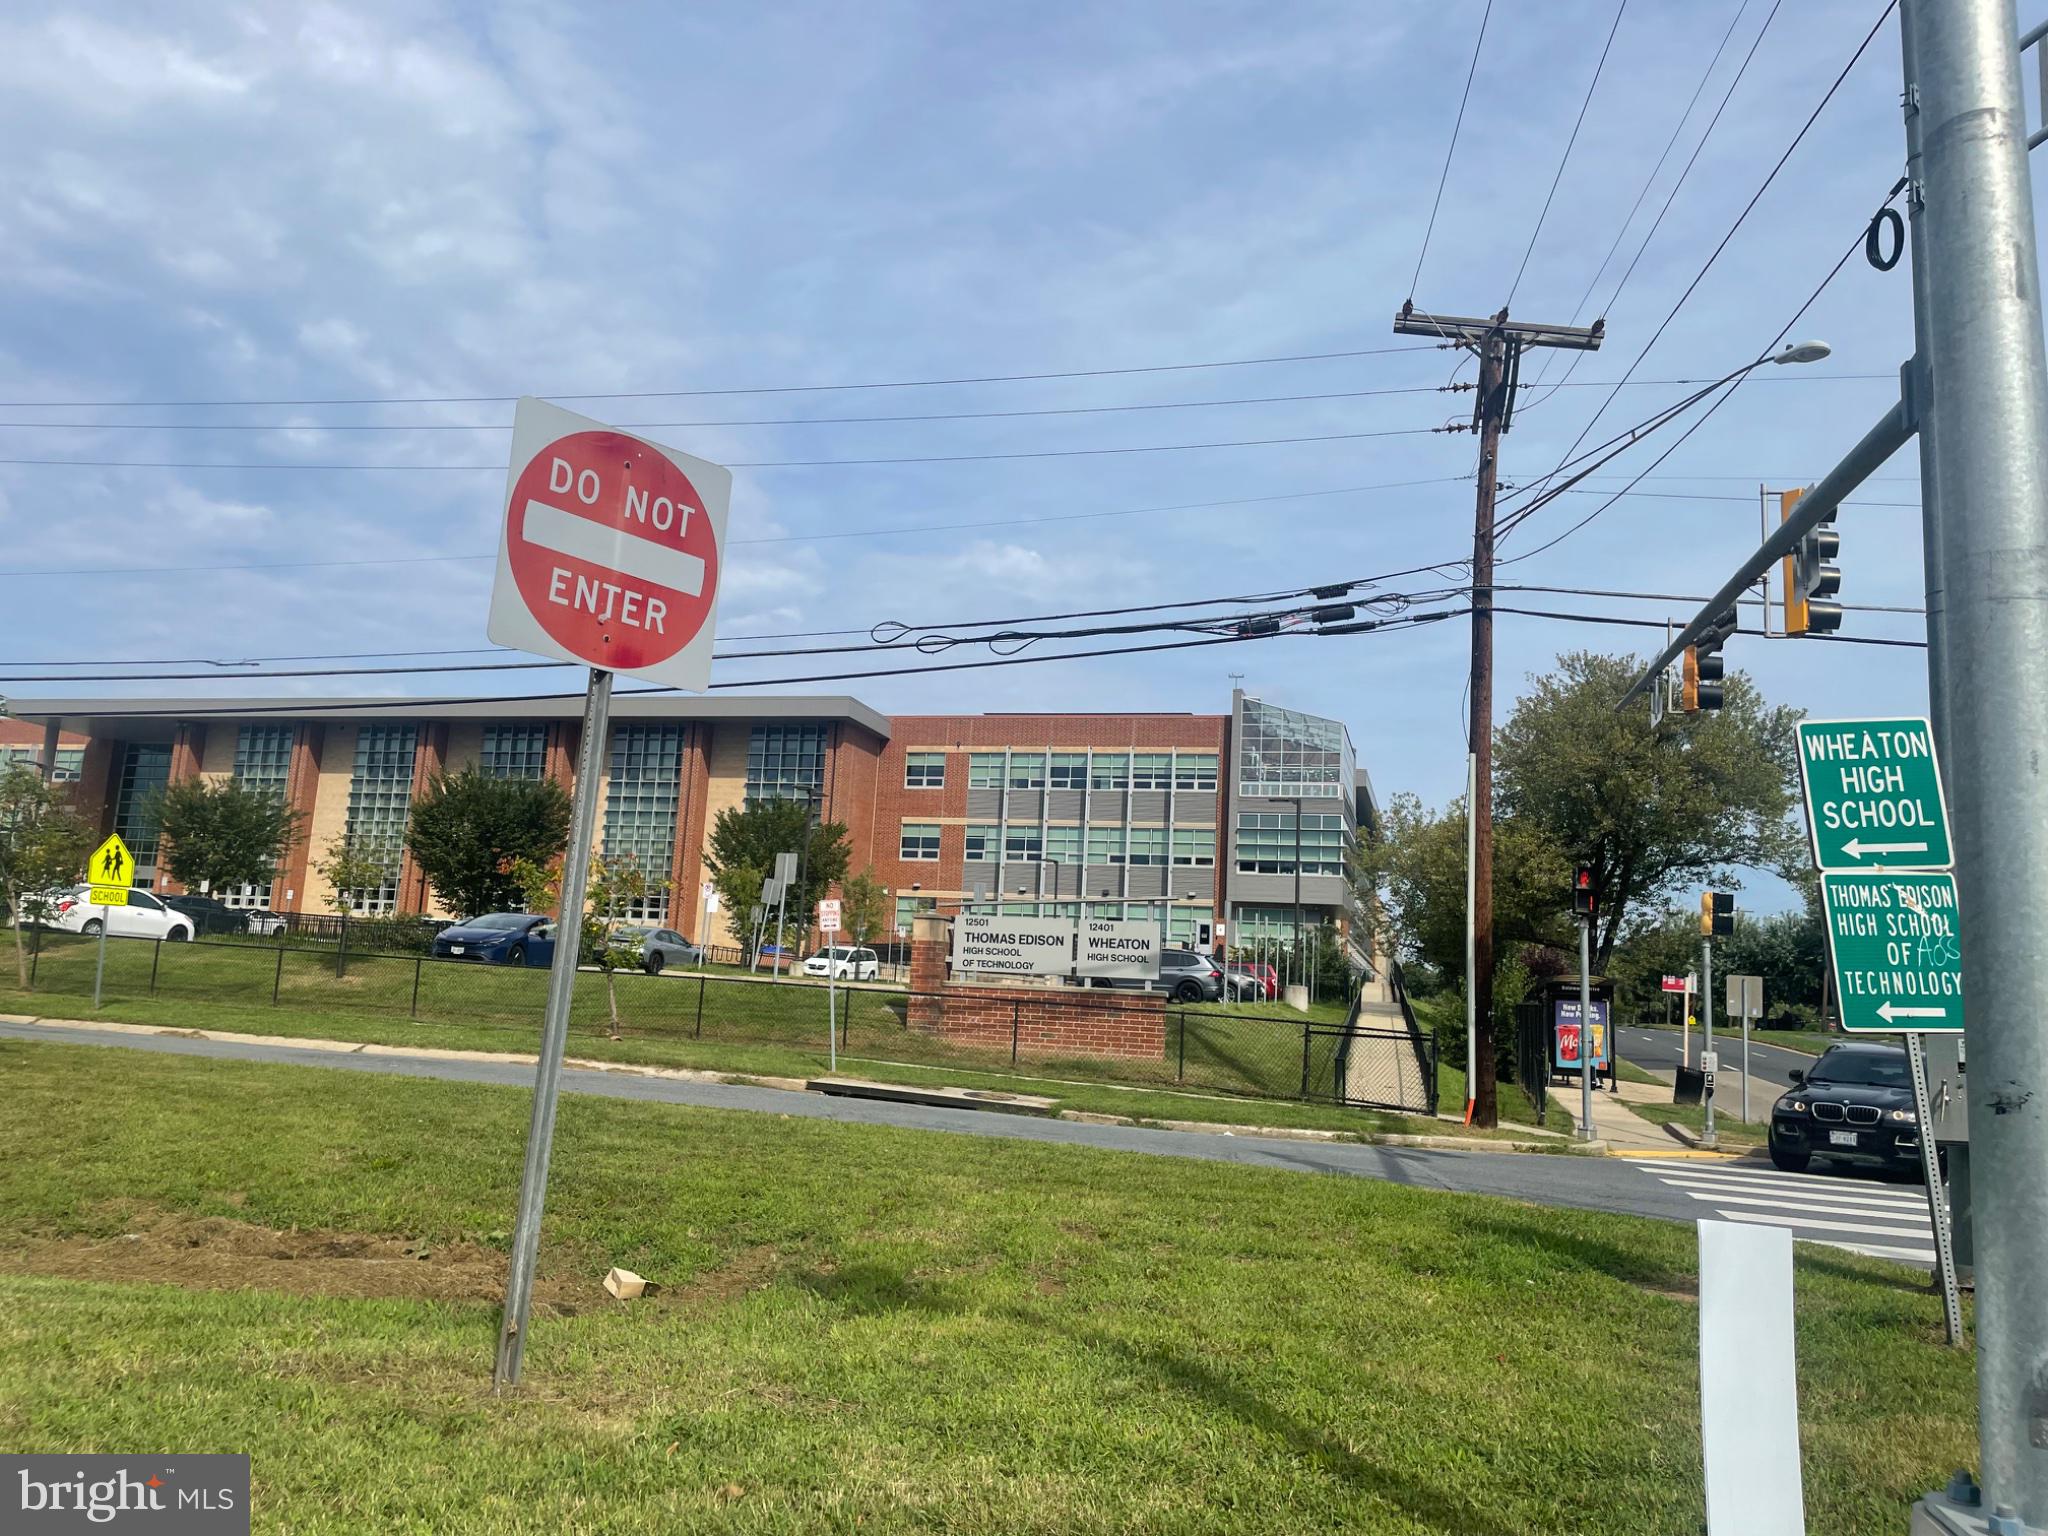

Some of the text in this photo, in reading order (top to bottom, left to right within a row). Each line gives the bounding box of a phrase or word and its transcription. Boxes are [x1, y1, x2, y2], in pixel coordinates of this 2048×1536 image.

[549, 457, 695, 538] DO NOT
[549, 567, 667, 634] ENTER
[1805, 731, 1929, 761] WHEATON
[1840, 765, 1905, 794] HIGH
[1823, 799, 1935, 829] SCHOOL
[92, 890, 125, 903] SCHOOL
[1829, 884, 1953, 908] THOMAS EDISON
[965, 917, 989, 927] 12501
[1088, 923, 1114, 932] 12401
[1837, 913, 1954, 937] HIGH SCHOOL
[964, 932, 1064, 947] THOMAS EDISON
[1088, 937, 1150, 950] WHEATON
[962, 946, 1022, 957] HIGH SCHOOL
[1087, 953, 1149, 964] HIGH SCHOOL
[1887, 942, 1912, 966] OF
[962, 959, 1034, 970] OF TECHNOLOGY
[1844, 971, 1962, 995] TECHNOLOGY
[1562, 1003, 1576, 1011] New
